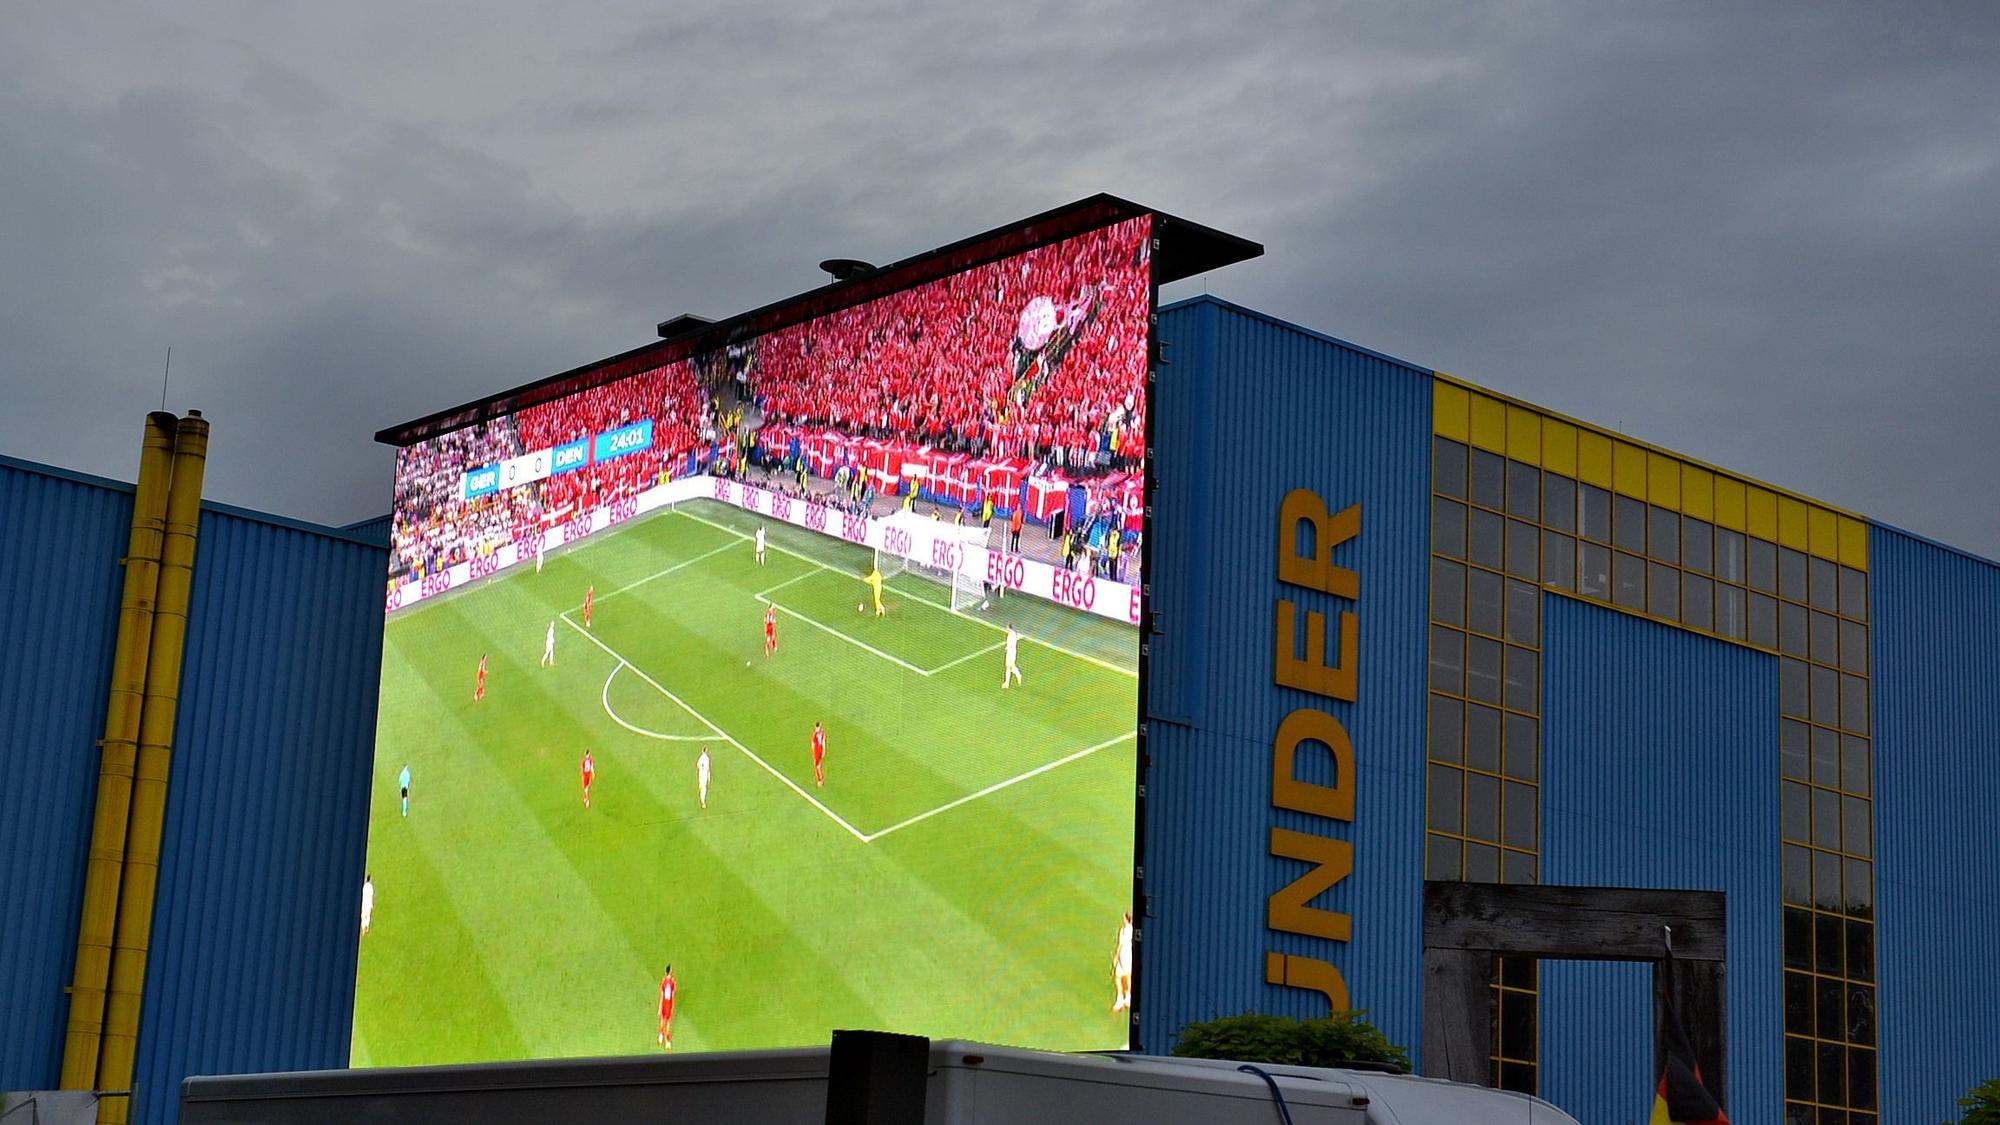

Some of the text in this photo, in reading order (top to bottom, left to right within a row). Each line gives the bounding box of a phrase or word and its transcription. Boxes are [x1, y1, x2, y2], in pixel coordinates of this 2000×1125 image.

[470, 428, 644, 491] GER 0 0 DEN 24:01
[421, 570, 451, 598] ERGO
[469, 551, 499, 579] ERGO
[563, 515, 592, 542] ERGO
[609, 497, 638, 524] ERGO
[805, 502, 827, 531] ERGO
[842, 512, 867, 543] ERGO
[884, 526, 912, 554] ERGO
[987, 551, 1025, 589] ERGO
[1053, 567, 1096, 609] ERGO
